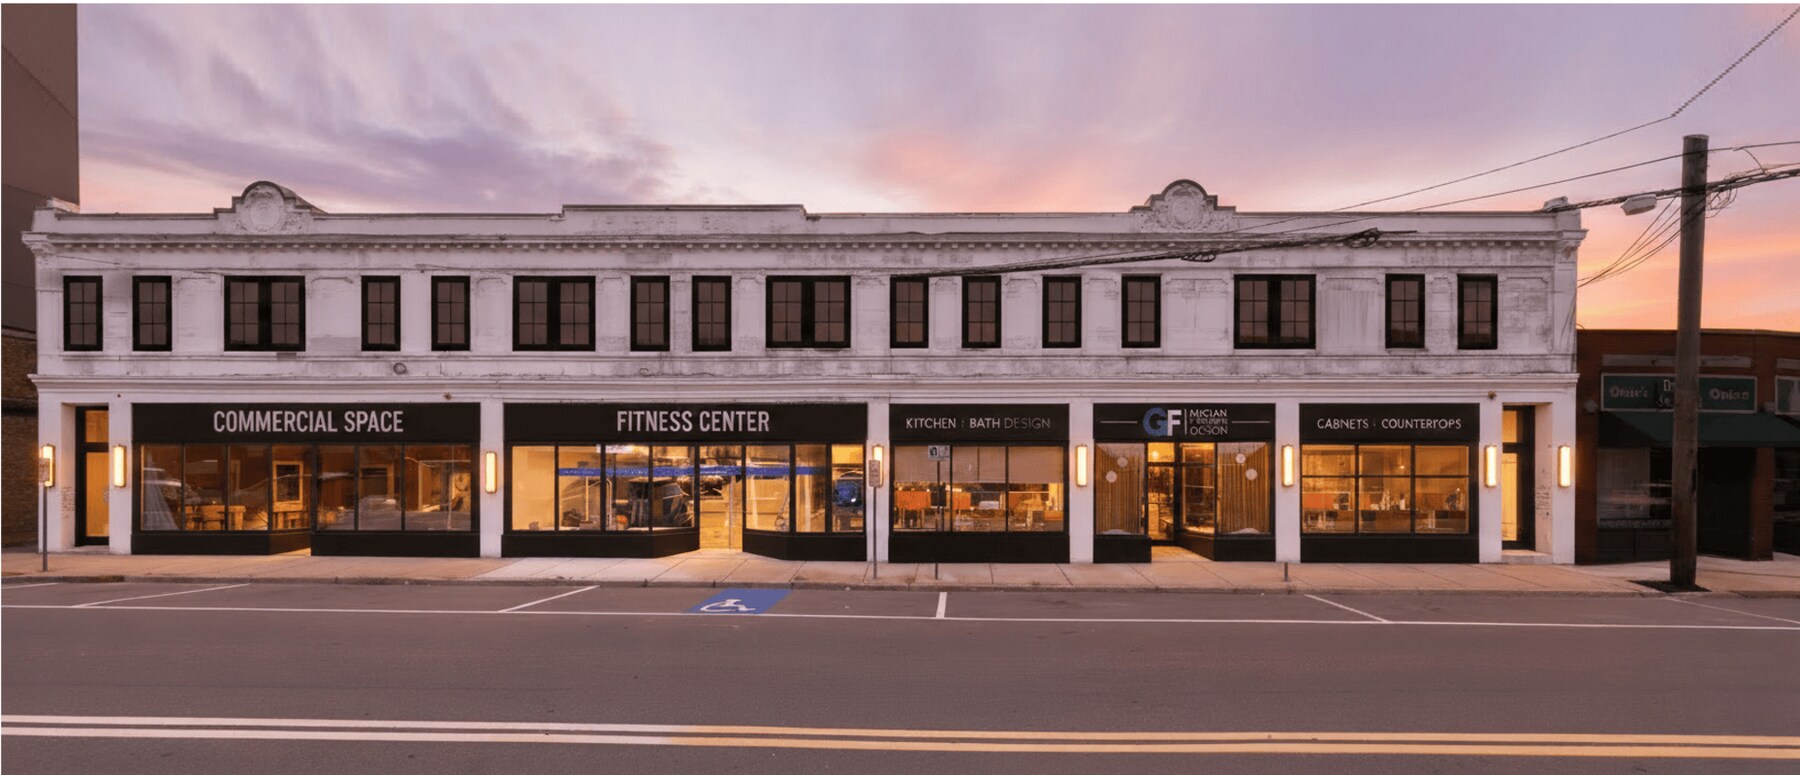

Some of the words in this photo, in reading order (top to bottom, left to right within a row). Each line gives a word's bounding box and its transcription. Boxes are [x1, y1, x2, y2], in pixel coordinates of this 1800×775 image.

[214, 410, 338, 433] COMMERCIAL
[344, 410, 404, 433] SPACE
[617, 410, 693, 432] FITNESS
[699, 410, 770, 432] CENTER
[905, 417, 957, 429] KITCHEN
[969, 417, 1001, 429] BATH
[1004, 417, 1051, 429] DESIGN
[1143, 407, 1182, 437] GF
